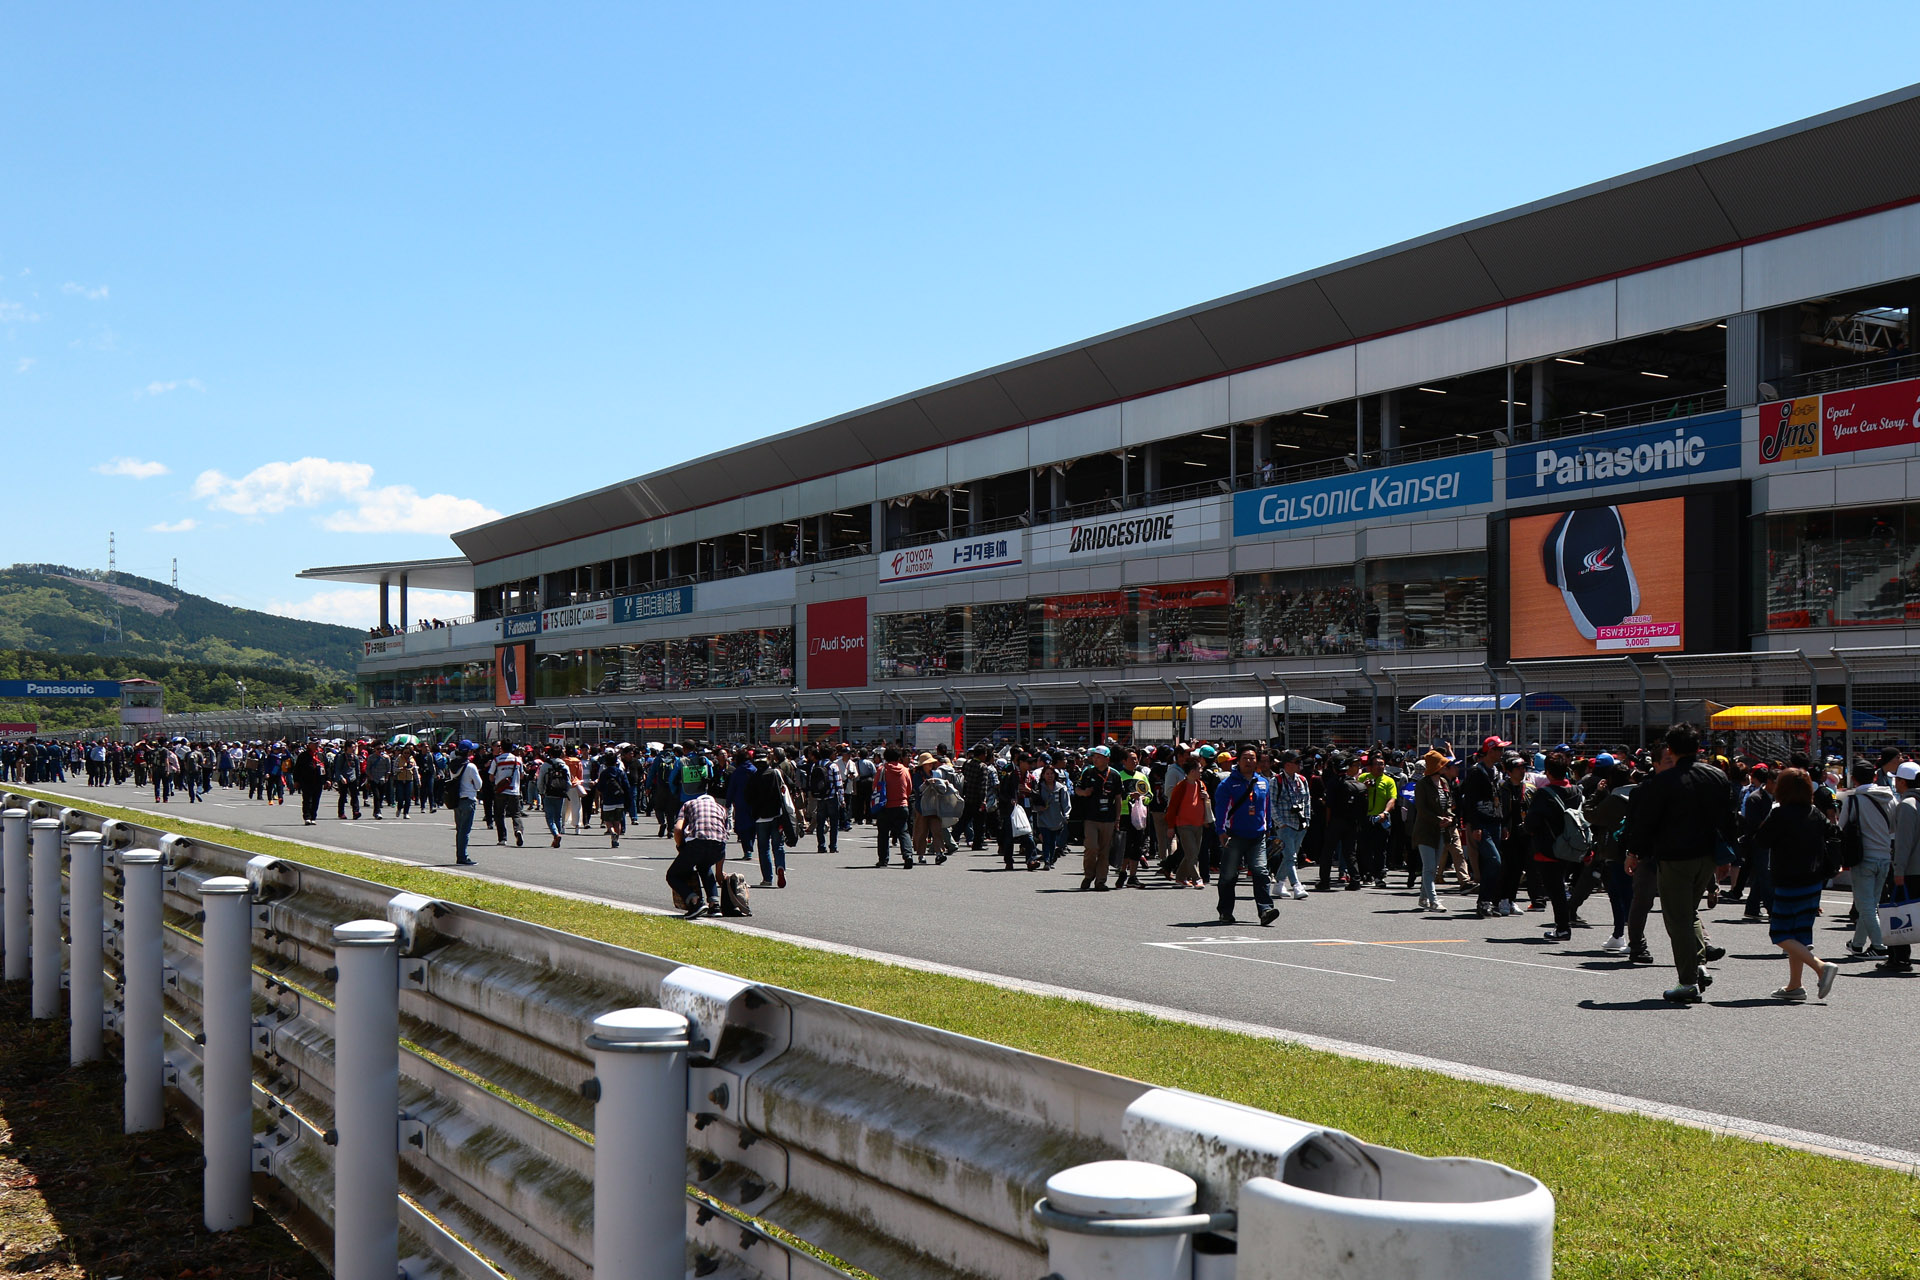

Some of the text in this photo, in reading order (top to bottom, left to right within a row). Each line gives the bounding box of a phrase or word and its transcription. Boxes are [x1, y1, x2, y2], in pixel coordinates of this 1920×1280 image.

[1826, 404, 1856, 422] Open!
[1832, 417, 1909, 440] Your Car Story.
[1536, 428, 1706, 487] Panasonic
[1069, 515, 1174, 553] BRIDGESTONE
[905, 548, 934, 563] TOYOTA
[953, 540, 1008, 564] トヨタ車体
[905, 561, 934, 573] AUTO BODY
[508, 616, 537, 635] Panasonic
[550, 614, 559, 629] TS
[560, 609, 582, 627] CUBIC
[583, 609, 595, 621] CARD
[1623, 615, 1652, 624] ORIZURU
[1600, 624, 1676, 637] FSWオリジナルキャップ
[820, 635, 864, 652] Audi Sport
[1625, 638, 1650, 646] 3,000円
[26, 683, 95, 694] Panasonic
[1210, 715, 1242, 728] EPSON
